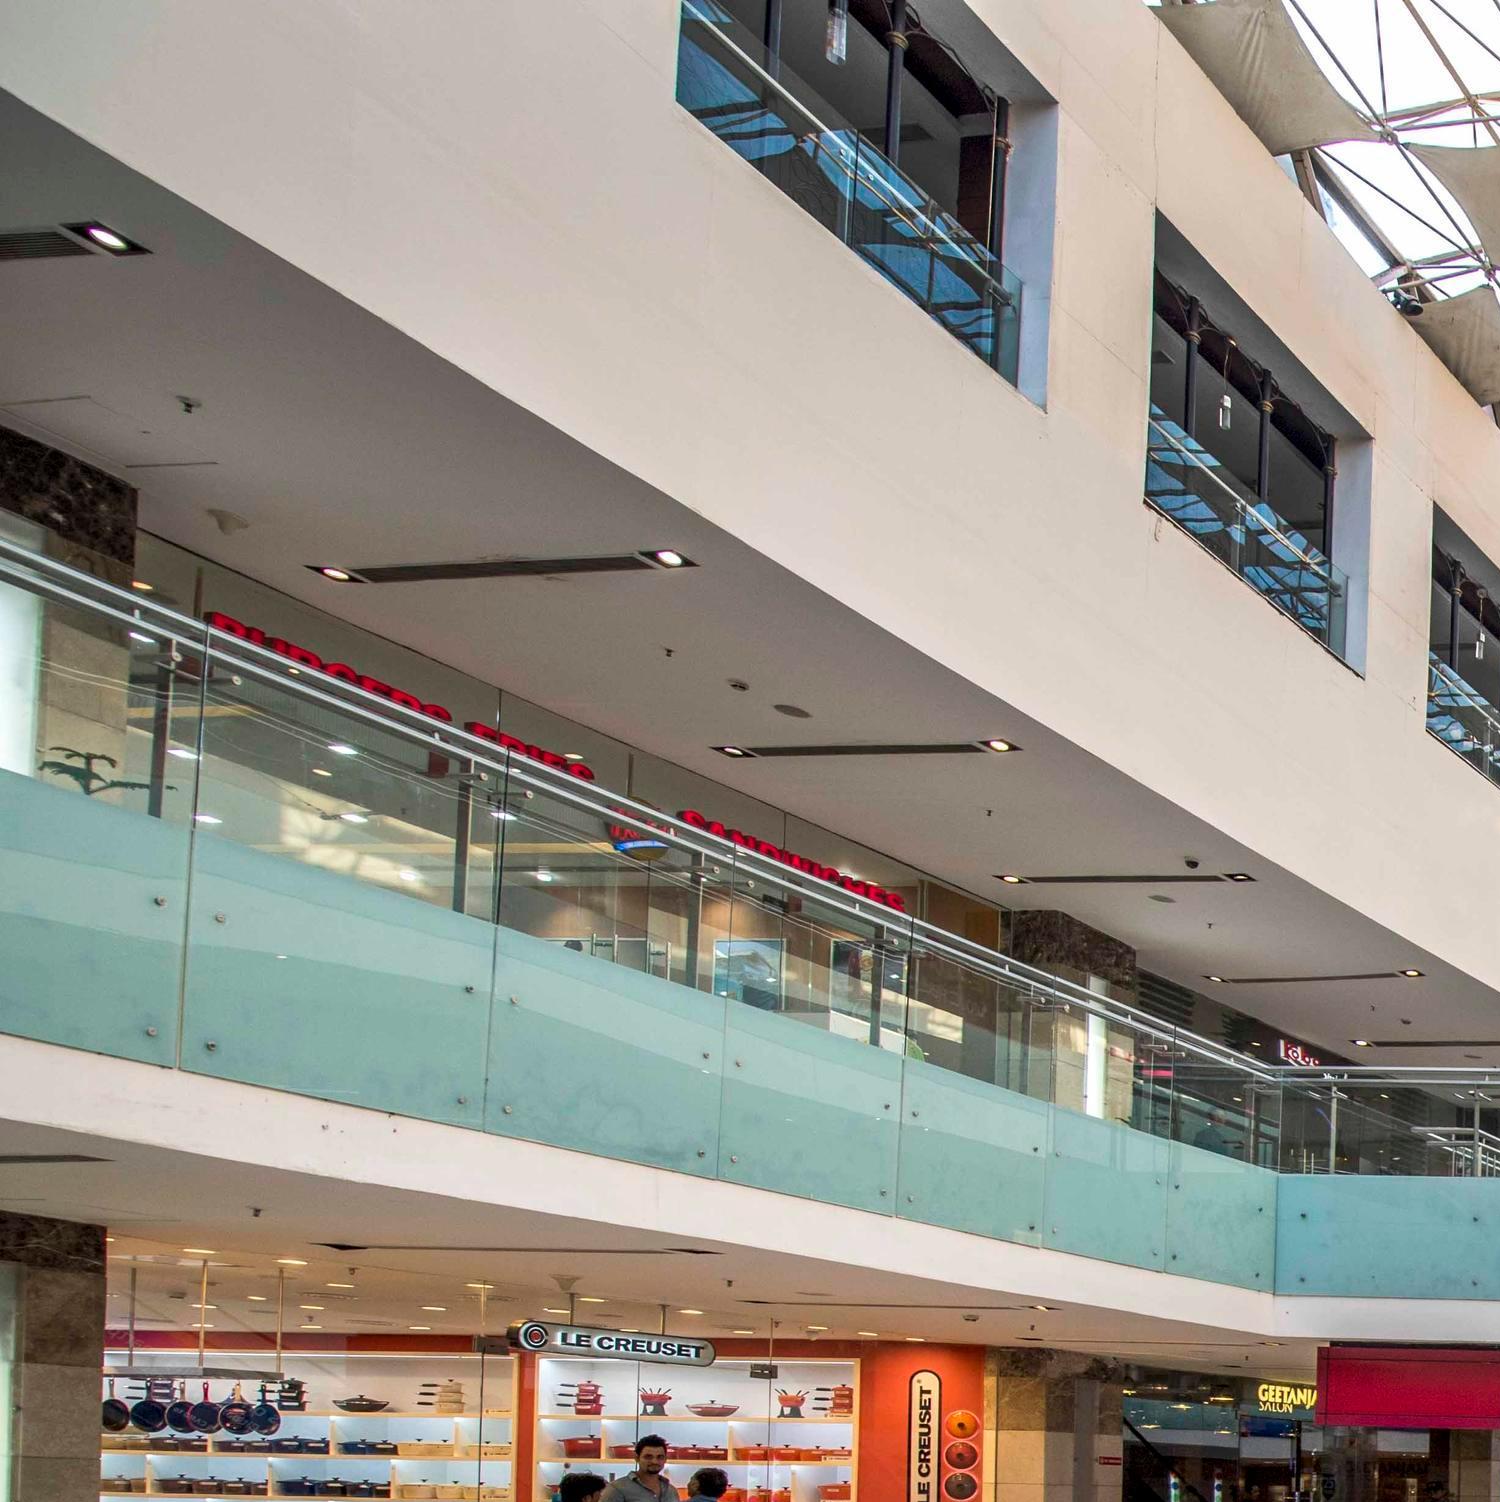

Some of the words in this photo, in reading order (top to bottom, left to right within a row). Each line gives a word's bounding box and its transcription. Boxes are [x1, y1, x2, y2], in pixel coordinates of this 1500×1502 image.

[561, 1332, 591, 1348] LE
[596, 1336, 705, 1358] CREUSET
[917, 1386, 932, 1479] CREUSET
